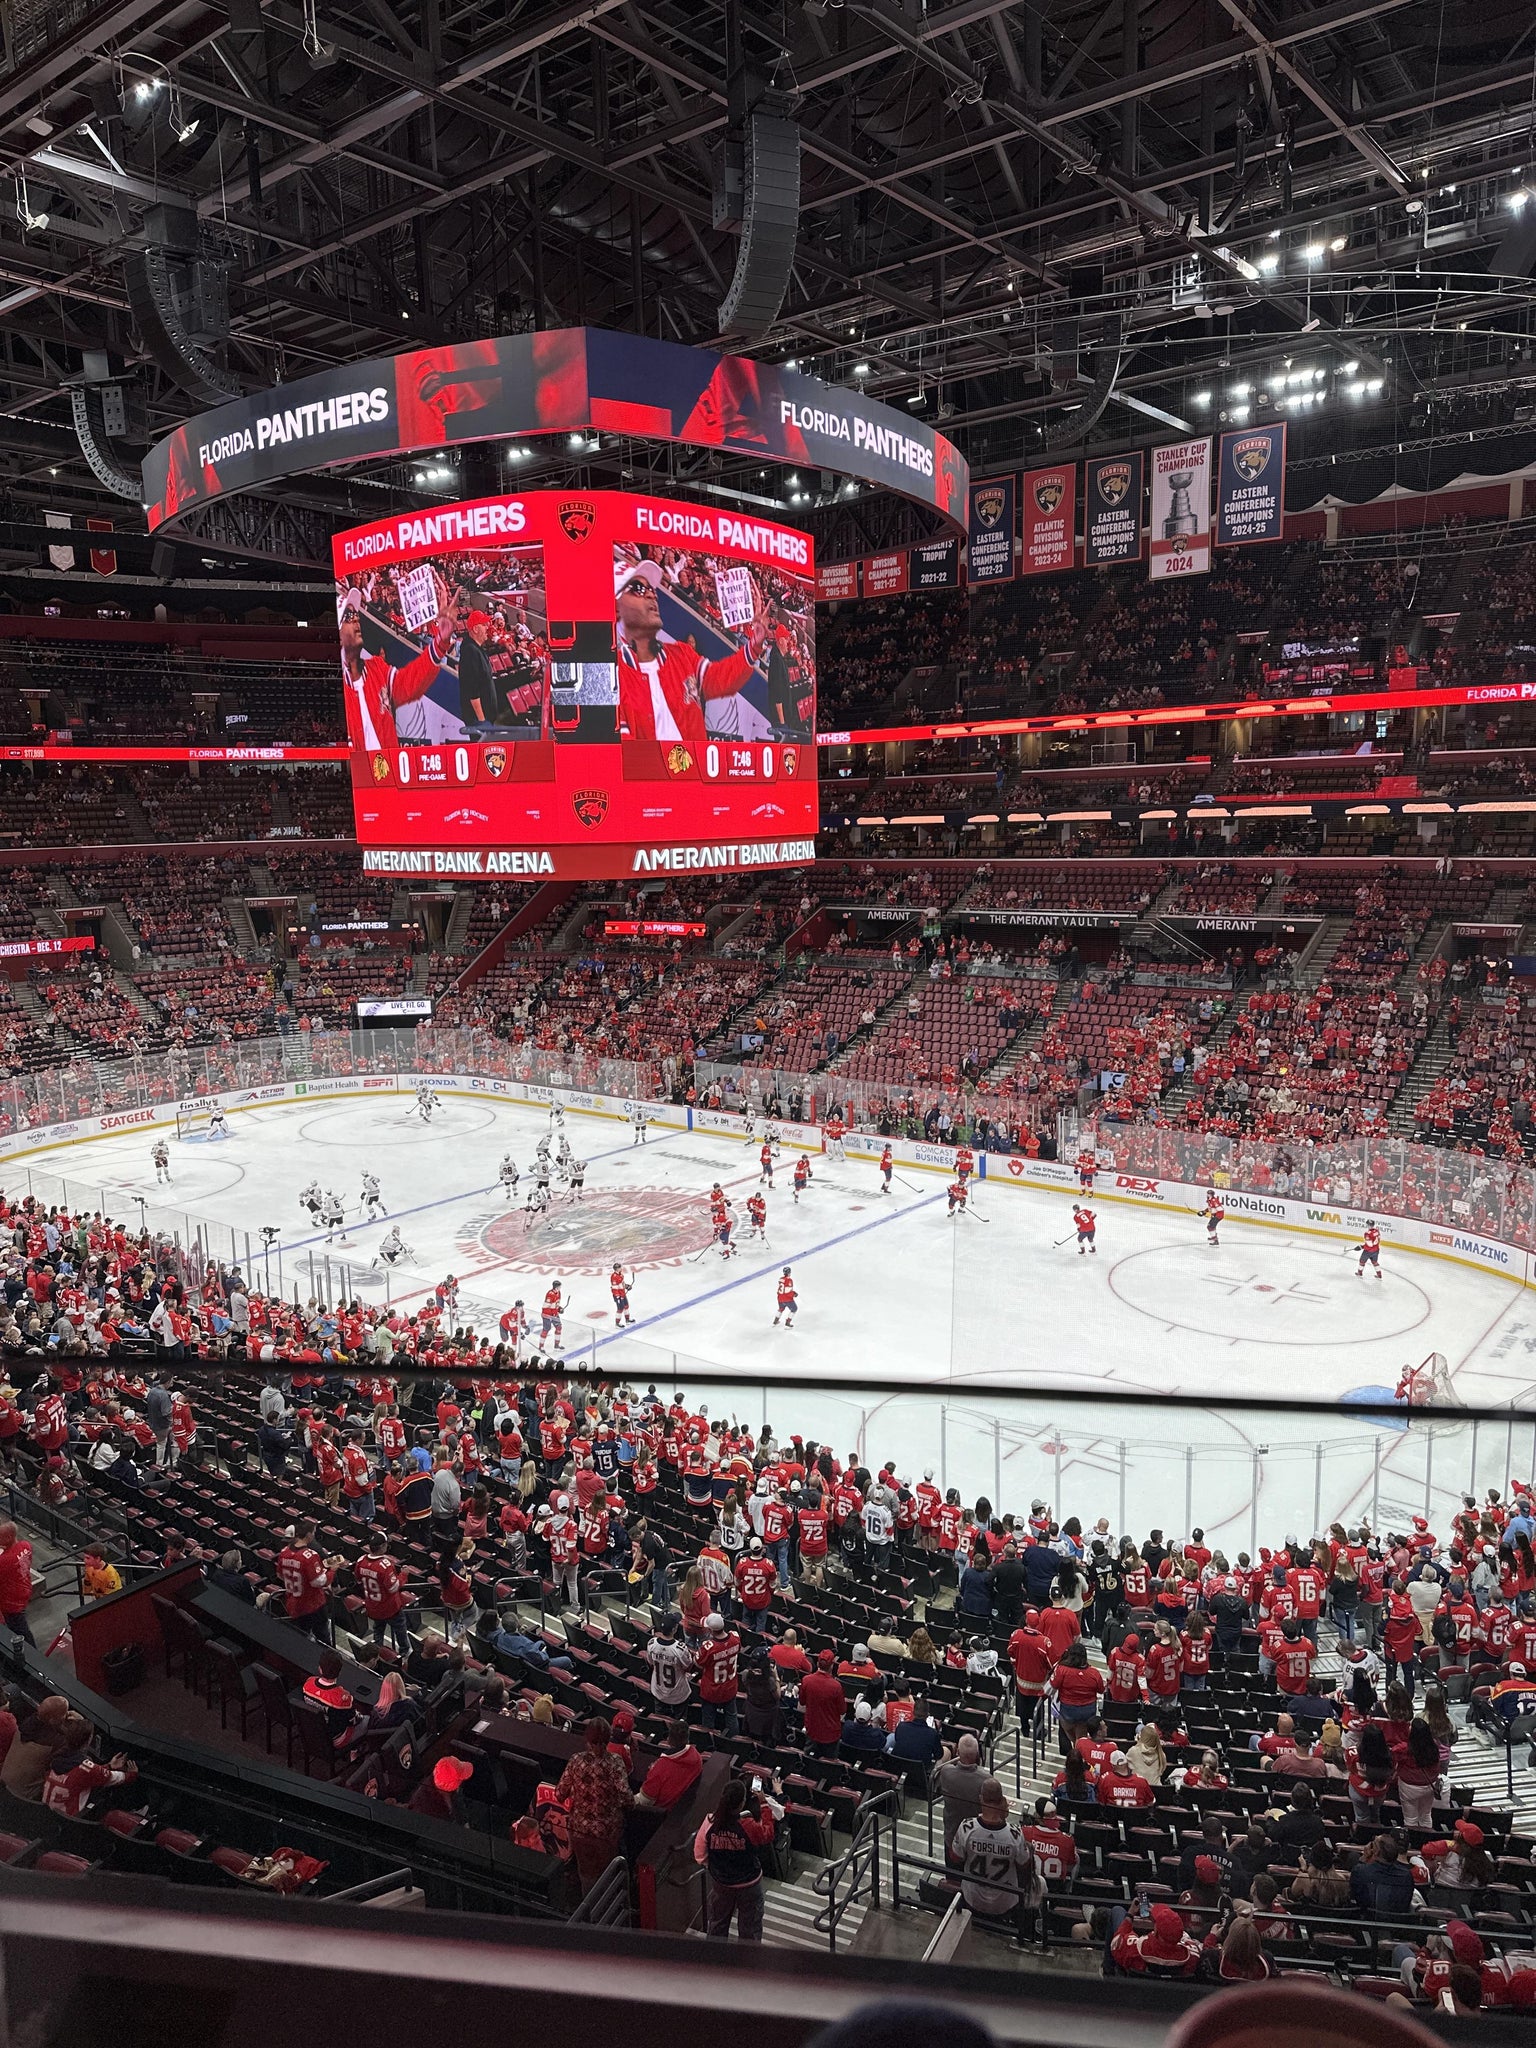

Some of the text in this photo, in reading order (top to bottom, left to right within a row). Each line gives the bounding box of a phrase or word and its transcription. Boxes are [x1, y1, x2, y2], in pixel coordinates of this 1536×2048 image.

[199, 387, 389, 467] FLORIDA PANTHERS
[781, 400, 933, 477] FLORIDA PANTHERS
[1156, 442, 1207, 462] STANLEY CUP
[1158, 455, 1205, 473] CHAMPIONS
[1232, 485, 1269, 501] EASTERN
[1224, 496, 1276, 514] CONFERENCE
[1098, 510, 1130, 524] EASTERN
[1225, 509, 1274, 526] CHAMPIONS
[345, 502, 526, 561] FLORIDA PANTHERS
[1033, 519, 1065, 533] ATLANTIC
[1091, 520, 1136, 536] CONFERENCE
[1231, 522, 1267, 537] 2024-25
[637, 508, 807, 564] FLORIDA PANTHERS
[976, 531, 1004, 544] EASTERN
[1033, 531, 1064, 544] DIVISION
[1092, 532, 1134, 547] CHAMPIONS
[971, 541, 1010, 556] CONFERENCE
[1028, 541, 1068, 556] CHAMPIONS
[1097, 544, 1128, 558] 2023-24
[872, 557, 897, 569] DIVISION
[922, 551, 946, 562] TROPHY
[972, 552, 1009, 567] CHAMPIONS
[1034, 554, 1062, 566] 2023-24
[822, 567, 849, 577] DIVISION
[977, 564, 1003, 577] 2022-23
[1165, 556, 1193, 573] 2024
[868, 567, 901, 580] CHAMPIONS
[921, 572, 947, 584] 2021-22
[726, 584, 742, 594] TIME
[819, 576, 853, 587] CHAMPIONS
[874, 578, 896, 590] 2021-22
[408, 604, 436, 629] YEAR
[724, 607, 752, 627] YEAR
[1467, 688, 1517, 699] FLORIDA
[189, 748, 284, 758] FLORIDA PANTHERS
[398, 751, 410, 784] 0
[455, 747, 469, 782] 0
[706, 744, 720, 778] 0
[763, 746, 773, 778] 0
[418, 773, 447, 781] PRE-GAME
[363, 850, 555, 874] AMERANT BANK ARENA
[632, 840, 816, 872] AMERANT BANK ARENA
[867, 911, 911, 921] AMERANT
[990, 915, 1099, 927] THE AMERANT VAULT
[347, 922, 389, 930] PANTHERS
[1196, 919, 1257, 931] AMERANT
[1456, 927, 1518, 936] 103 104
[37, 942, 52, 952] DEC.
[53, 941, 62, 951] 12
[308, 1079, 360, 1093] Baptist Health
[363, 1079, 393, 1087] ESPN
[260, 1087, 285, 1095] ACTION
[100, 1109, 156, 1130] SEATGEEK
[915, 1144, 953, 1156] COMCAST
[915, 1153, 954, 1165] BUSINESS
[504, 1166, 513, 1175] 98
[573, 1164, 582, 1173] 16
[1026, 1170, 1074, 1182] Children's Hospital
[821, 1183, 884, 1200] CELSIUS
[1116, 1176, 1160, 1193] DEX
[1125, 1188, 1165, 1200] imaging
[334, 1199, 340, 1209] 6
[1081, 1214, 1088, 1223] 9
[1306, 1209, 1342, 1224] WM
[454, 1213, 501, 1239] ARENA
[1432, 1235, 1451, 1244] MIKE'S
[455, 1240, 500, 1264] BANK
[1453, 1237, 1508, 1264] AMAZING
[51, 1407, 66, 1431] 72
[383, 1431, 395, 1448] 19
[666, 1444, 679, 1458] 19
[598, 1455, 613, 1470] 19
[918, 1499, 932, 1515] 72
[585, 1522, 601, 1542] 72
[768, 1517, 782, 1534] 16
[867, 1515, 881, 1536] 16
[941, 1517, 955, 1536] 16
[722, 1528, 734, 1544] 16
[803, 1526, 823, 1541] 72
[283, 1569, 302, 1597] 63
[362, 1577, 382, 1602] 19
[744, 1576, 767, 1596] 22
[1097, 1574, 1118, 1590] 16
[1126, 1575, 1146, 1594] 63
[1298, 1582, 1316, 1602] 16
[654, 1661, 676, 1688] 19
[714, 1655, 738, 1684] 63
[1163, 1661, 1176, 1681] 5
[1288, 1658, 1307, 1678] 19
[1115, 1667, 1135, 1689] 19
[1113, 1787, 1137, 1797] BARKOV
[972, 1841, 1010, 1856] FORSLING
